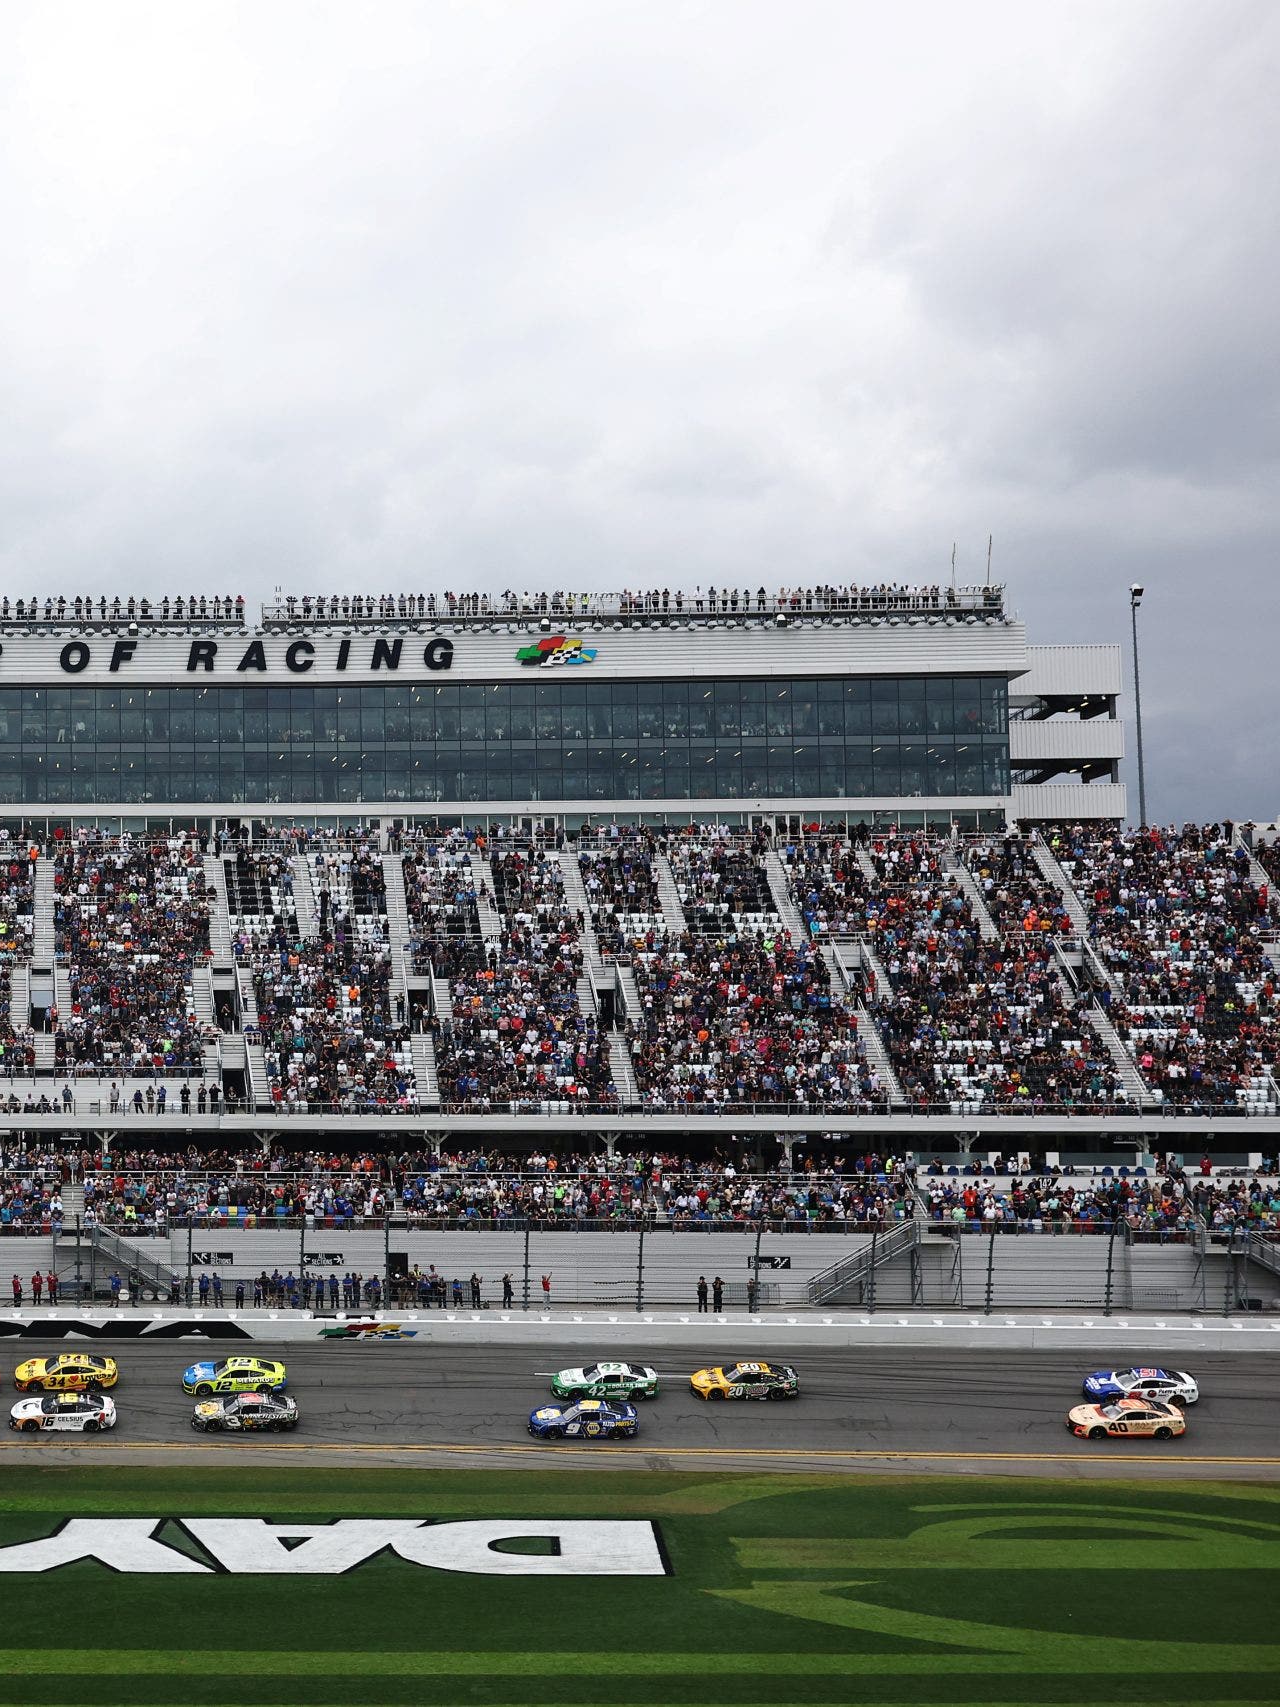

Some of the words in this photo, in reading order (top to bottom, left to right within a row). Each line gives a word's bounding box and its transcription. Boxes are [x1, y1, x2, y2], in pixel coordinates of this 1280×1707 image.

[60, 640, 138, 673] OF
[188, 638, 455, 673] RACING
[601, 1364, 622, 1372] 42
[740, 1363, 760, 1371] 20
[1140, 1368, 1158, 1378] 51
[47, 1377, 66, 1388] 34
[215, 1381, 233, 1391] 12
[588, 1385, 607, 1397] 42
[727, 1386, 744, 1397] 20
[41, 1416, 55, 1427] 16
[224, 1415, 241, 1427] 3
[565, 1423, 581, 1434] 9
[1108, 1422, 1129, 1433] 40
